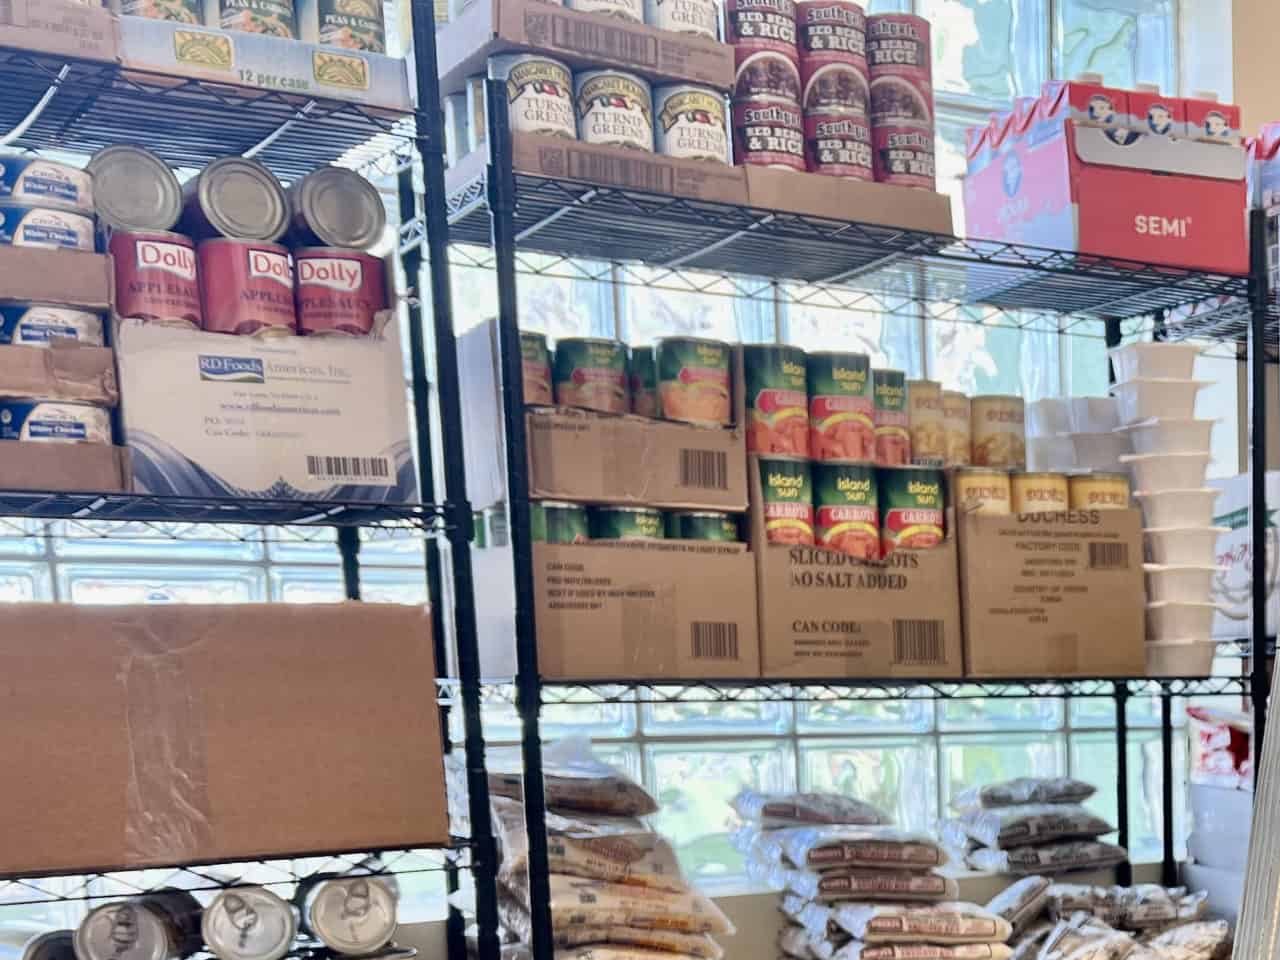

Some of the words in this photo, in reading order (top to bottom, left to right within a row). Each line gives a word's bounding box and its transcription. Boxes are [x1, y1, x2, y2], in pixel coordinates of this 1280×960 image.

[741, 22, 755, 36] &
[811, 37, 825, 49] &
[875, 50, 916, 64] RICE
[238, 69, 256, 83] 12
[257, 73, 277, 88] per
[749, 137, 761, 150] &
[821, 150, 833, 162] &
[1135, 215, 1187, 237] SEMI
[254, 253, 289, 277] Dol
[300, 261, 358, 287] Dolly
[201, 358, 222, 370] RD
[223, 358, 262, 372] Foods
[768, 473, 803, 487] Island
[837, 477, 870, 490] Island
[777, 487, 798, 497] sun
[908, 481, 939, 494] Island
[790, 549, 846, 566] SLICED
[816, 572, 852, 588] SALT
[857, 573, 907, 590] ADDED
[792, 620, 818, 633] CAN
